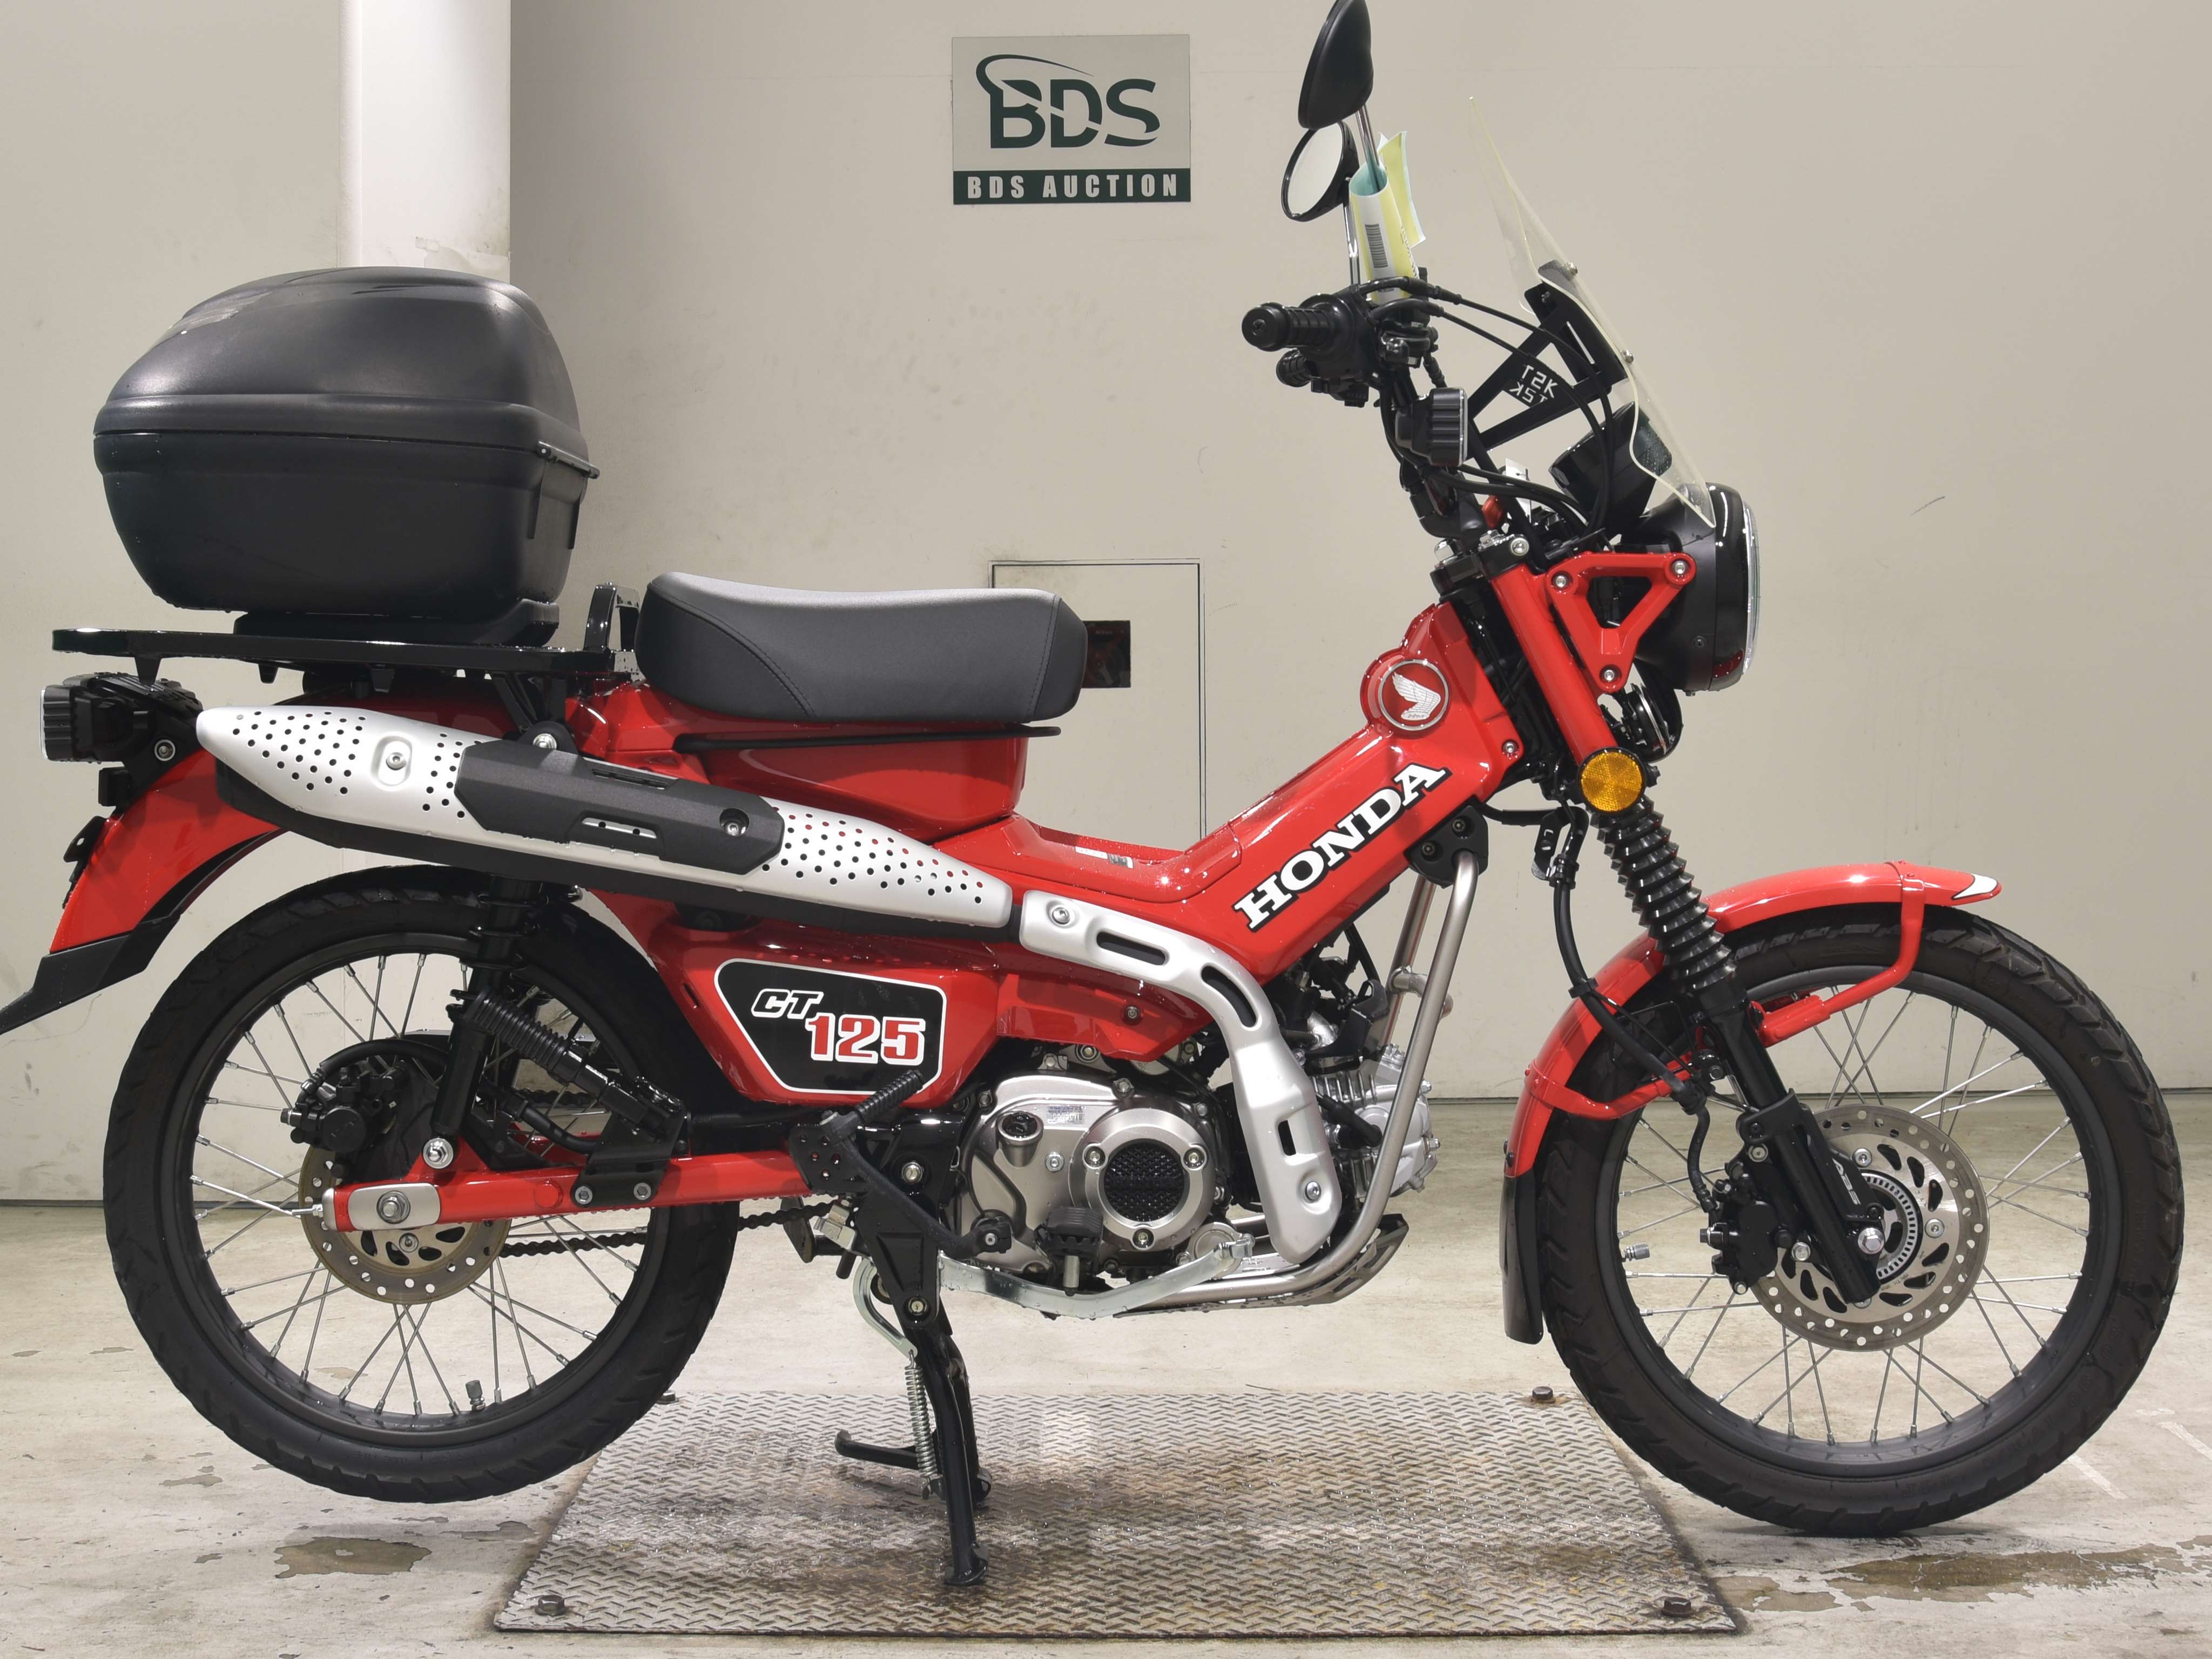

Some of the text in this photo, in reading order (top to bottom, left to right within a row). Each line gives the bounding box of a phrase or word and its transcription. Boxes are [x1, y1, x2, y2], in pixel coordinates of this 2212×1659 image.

[976, 54, 1161, 149] BDS
[967, 173, 1177, 199] BDS AUCTION
[1232, 763, 1453, 933] HONDA
[751, 988, 824, 1020] CT
[805, 1012, 926, 1066] 125
[1832, 1157, 1862, 1205] ABS
